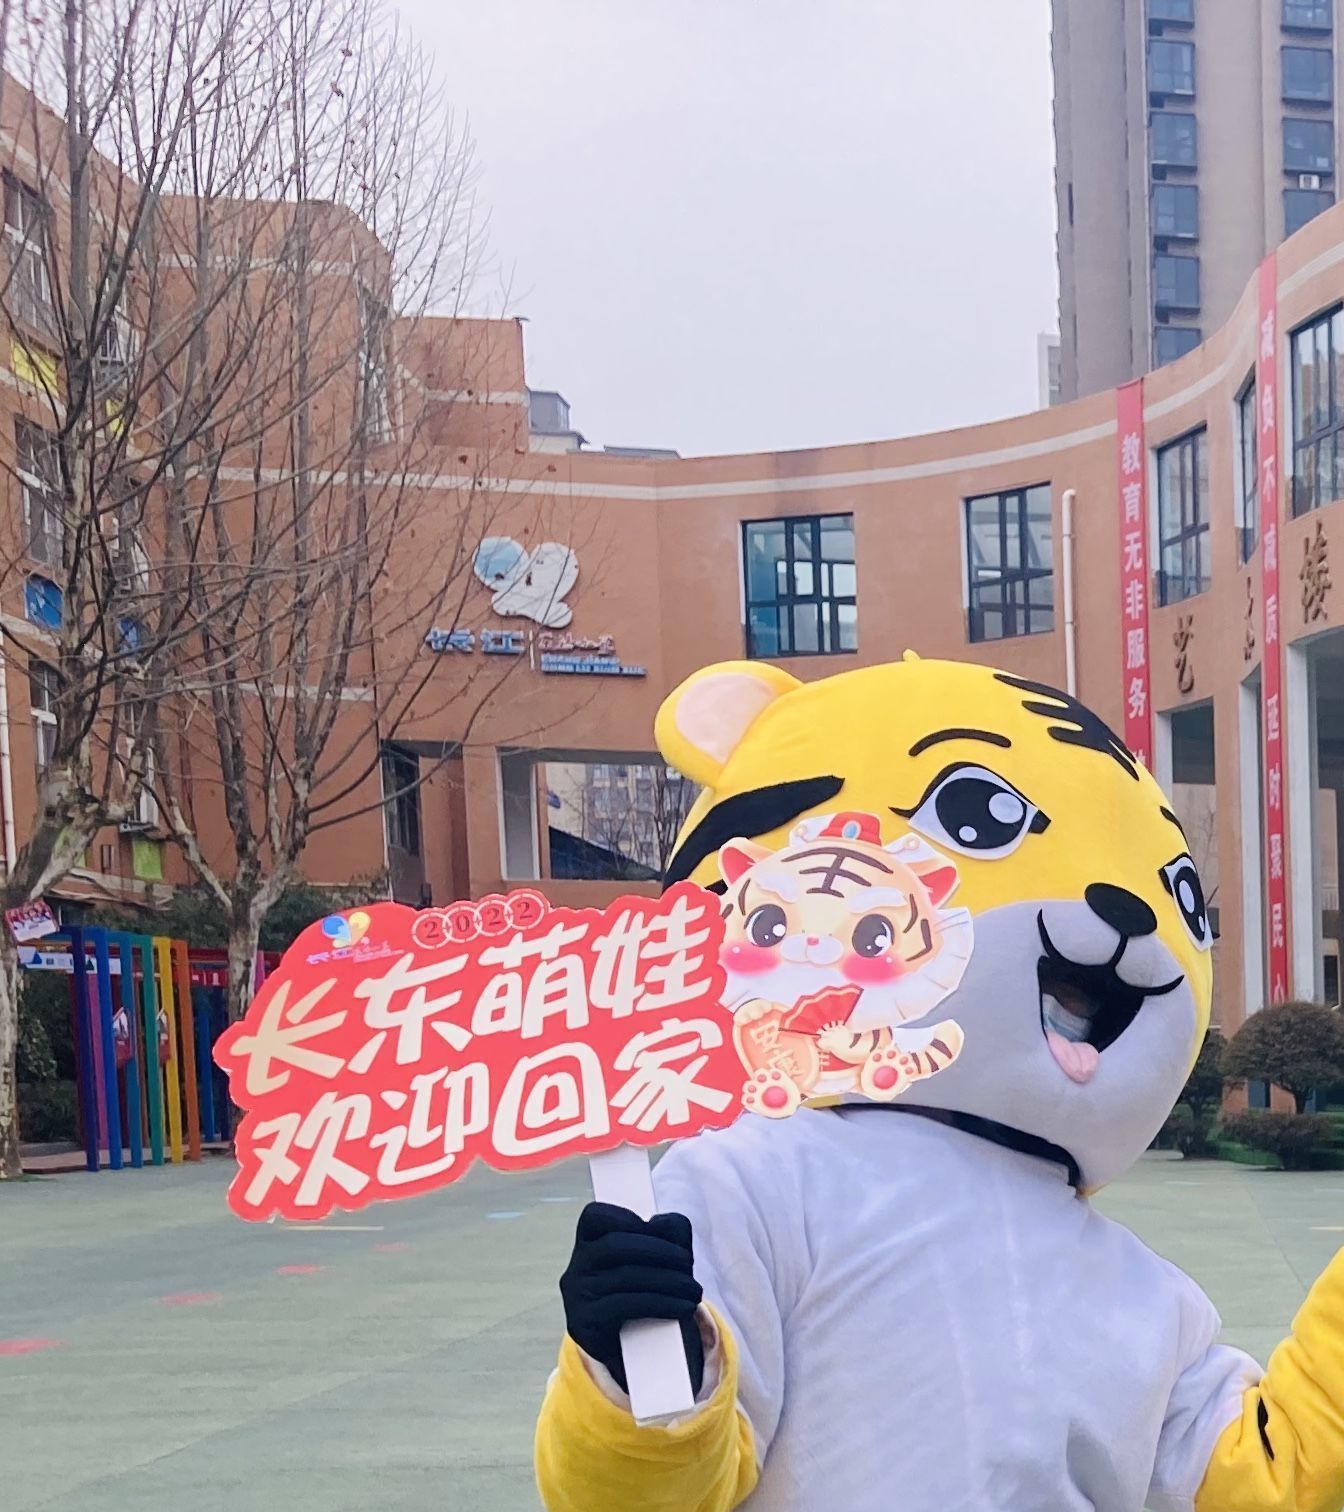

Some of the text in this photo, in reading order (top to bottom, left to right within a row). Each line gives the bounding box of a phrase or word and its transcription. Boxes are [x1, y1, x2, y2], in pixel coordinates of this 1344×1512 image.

[230, 895, 712, 1097] 长东萌娃
[423, 901, 533, 940] 2022
[244, 1018, 734, 1207] 欢迎回家
